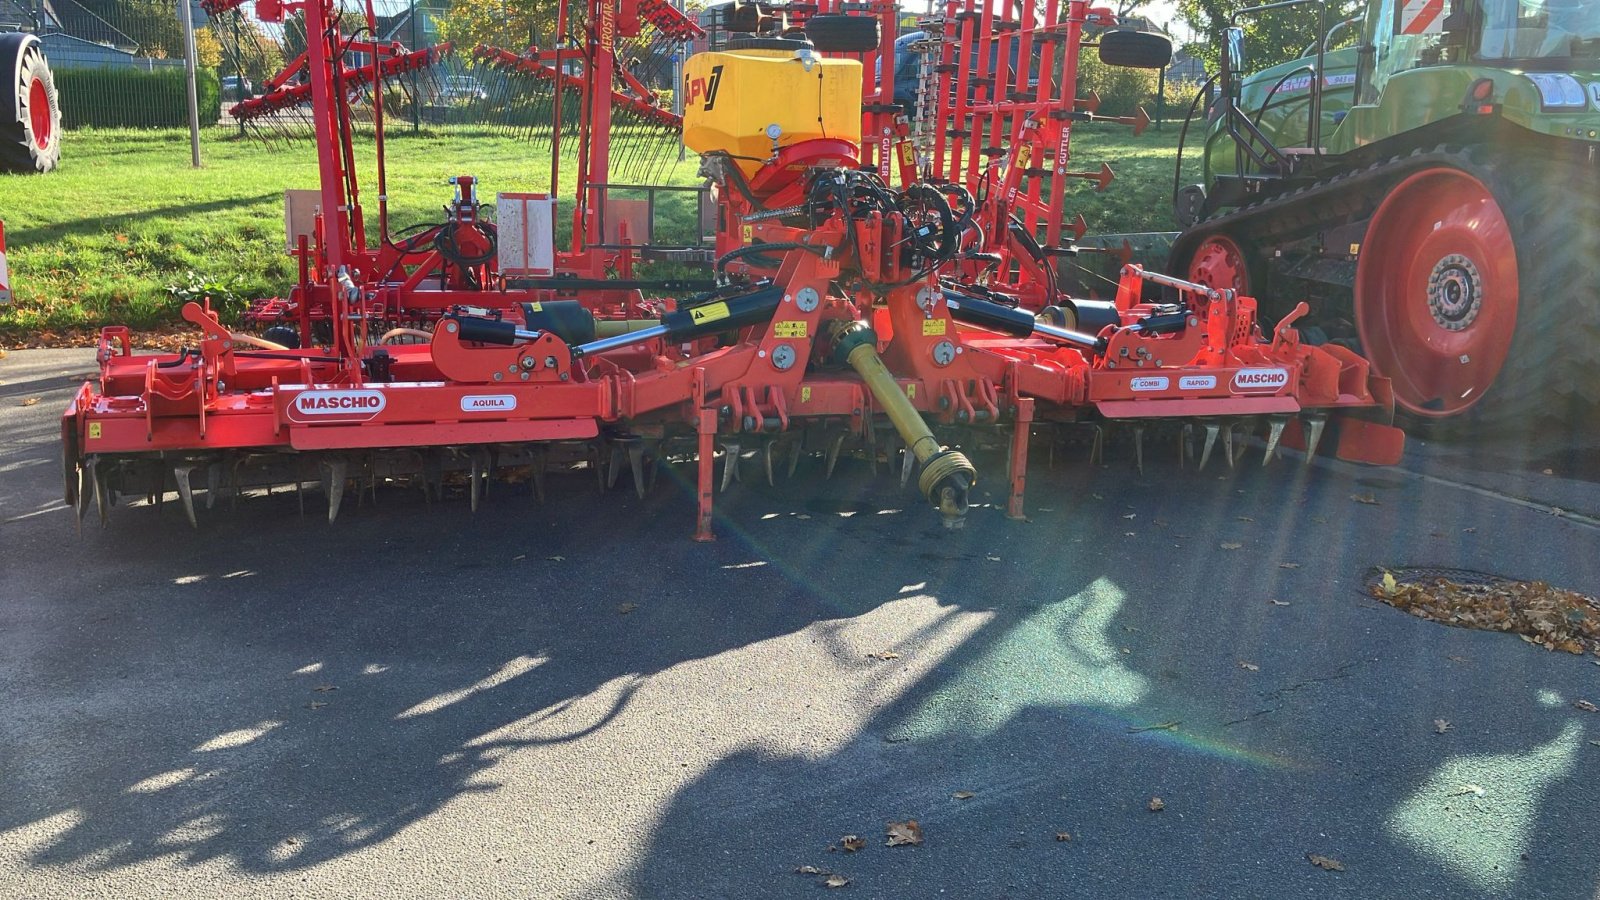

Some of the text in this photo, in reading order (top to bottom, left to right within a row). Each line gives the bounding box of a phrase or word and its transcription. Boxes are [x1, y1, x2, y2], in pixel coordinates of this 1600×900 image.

[684, 75, 716, 107] APV
[1237, 373, 1285, 384] MASCHIO
[301, 396, 380, 410] MASCHIO
